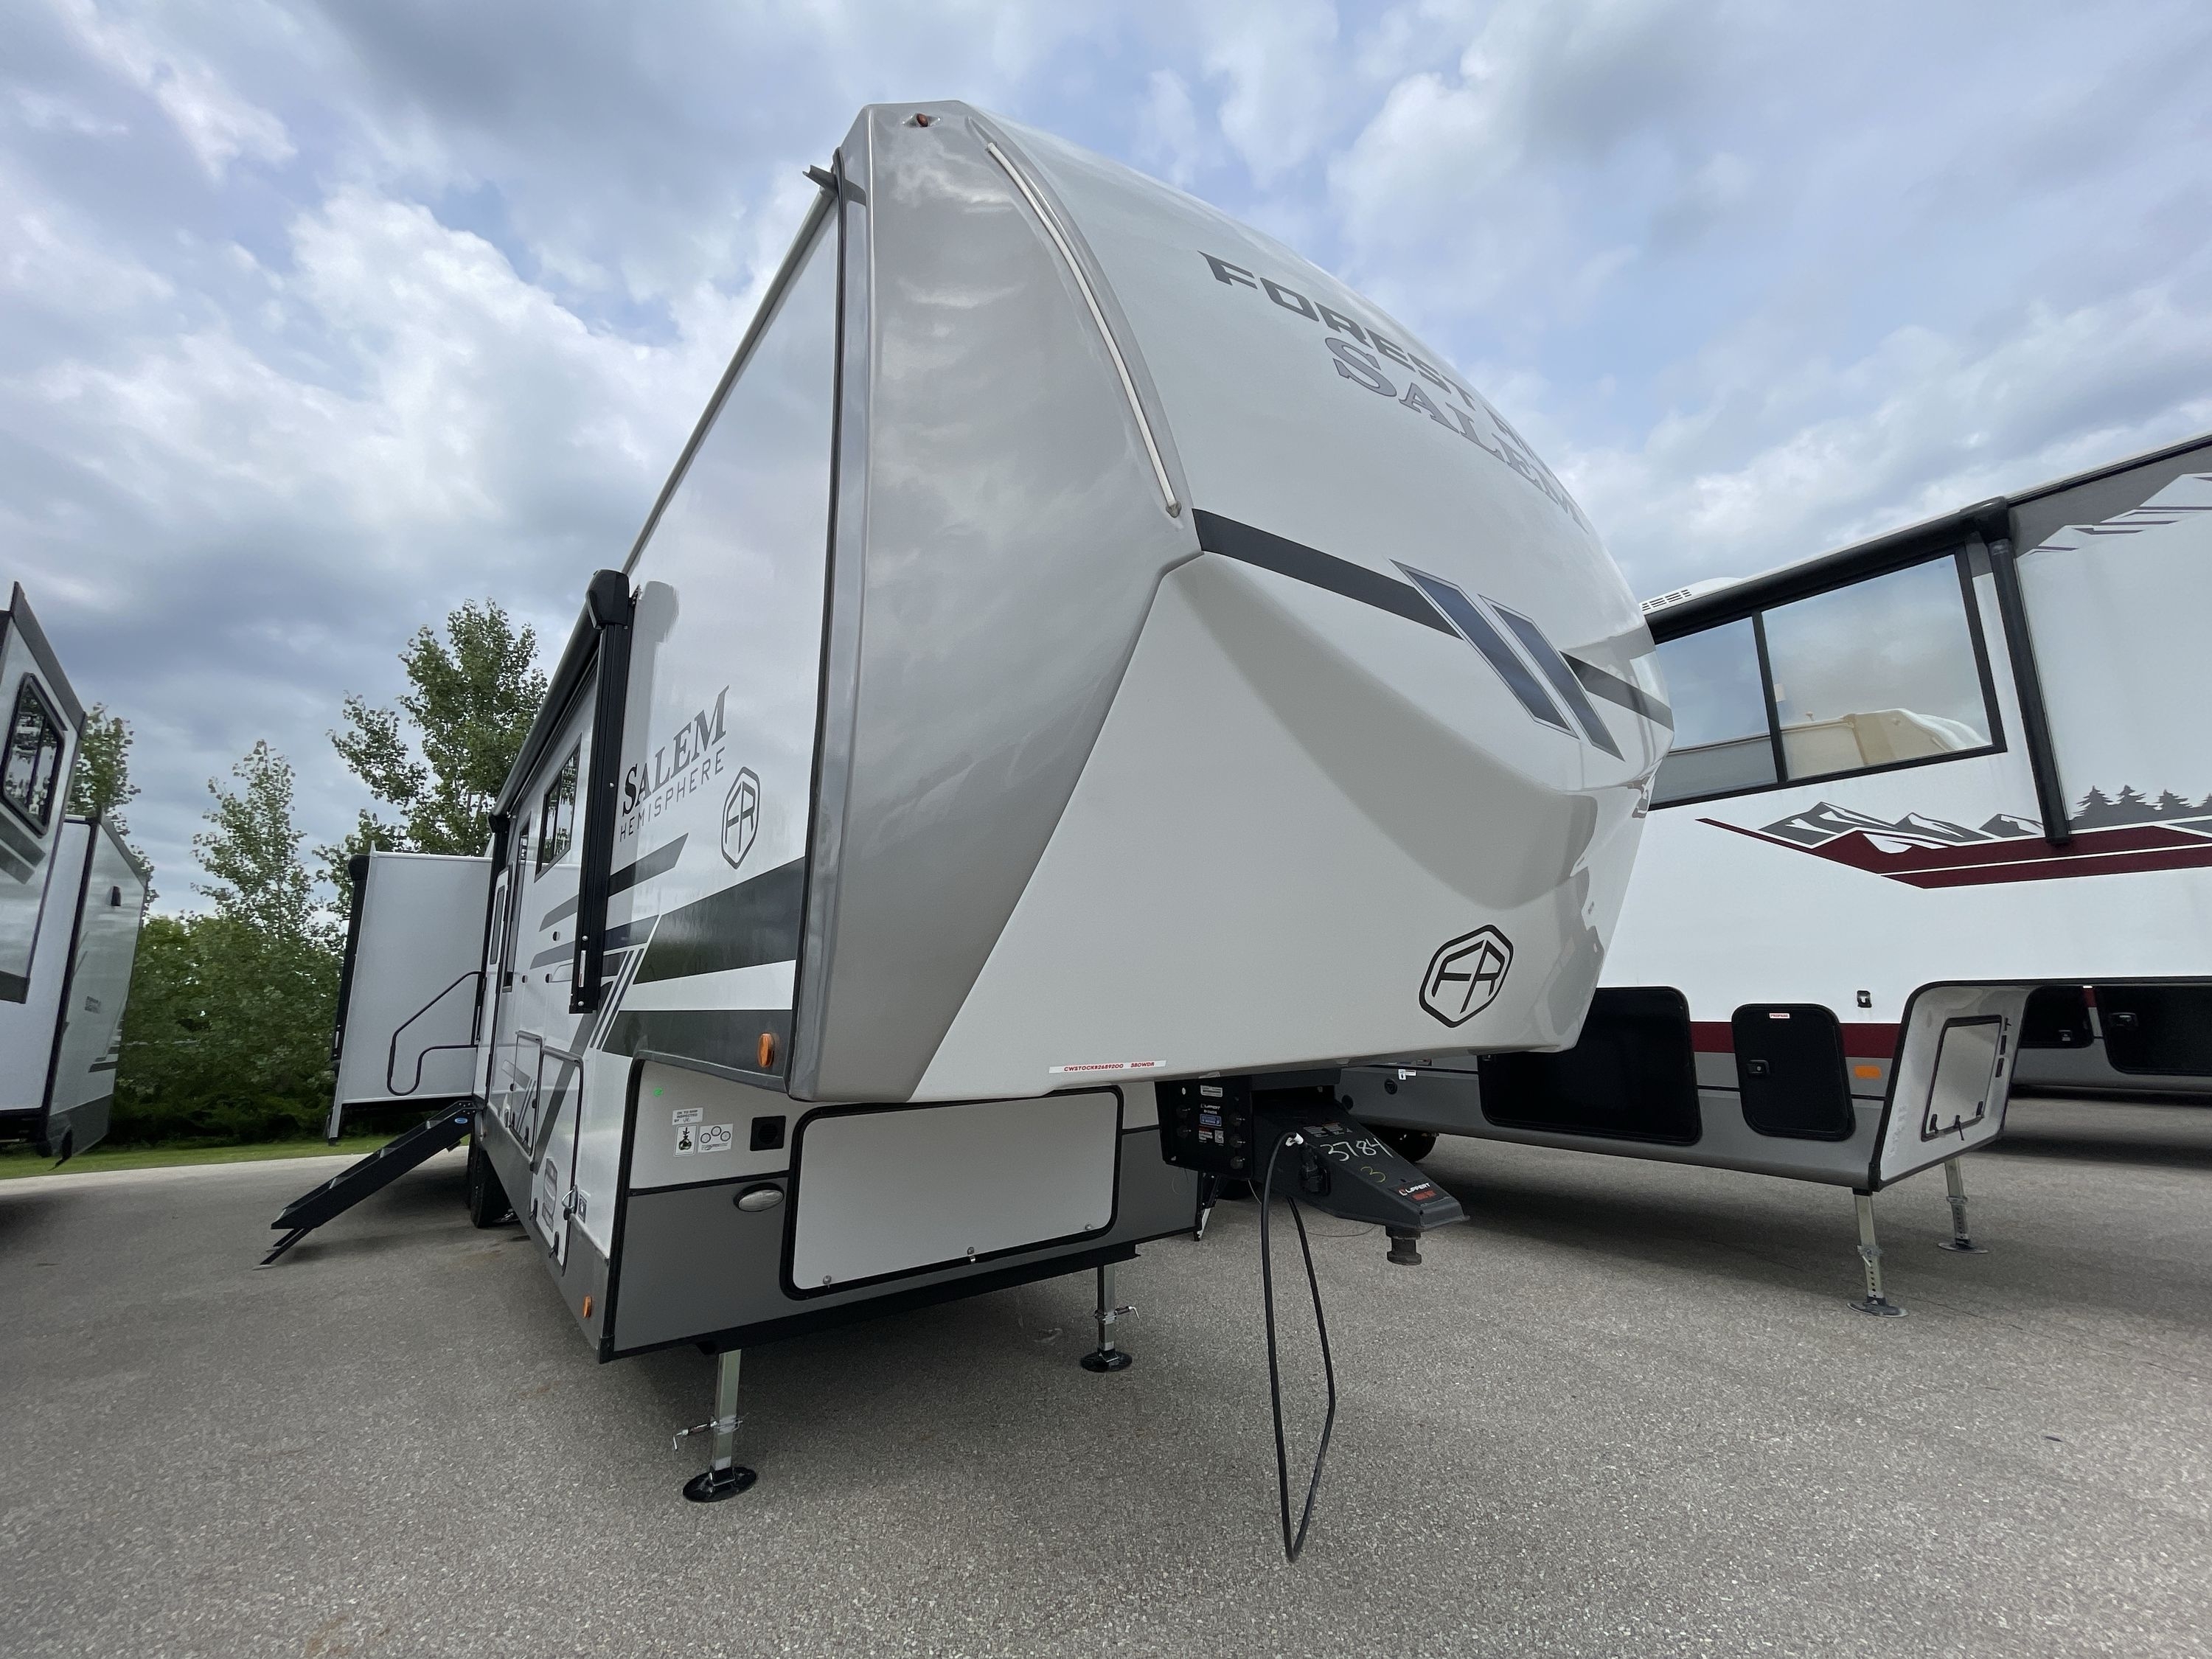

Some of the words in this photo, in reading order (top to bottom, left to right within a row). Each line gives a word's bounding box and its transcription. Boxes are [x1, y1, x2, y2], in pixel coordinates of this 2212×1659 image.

[1197, 250, 1476, 411] FOREST
[619, 745, 726, 843] HEMISPHERE
[622, 684, 730, 818] SALEM
[1320, 1137, 1394, 1161] 3784
[1360, 1166, 1386, 1183] 3
